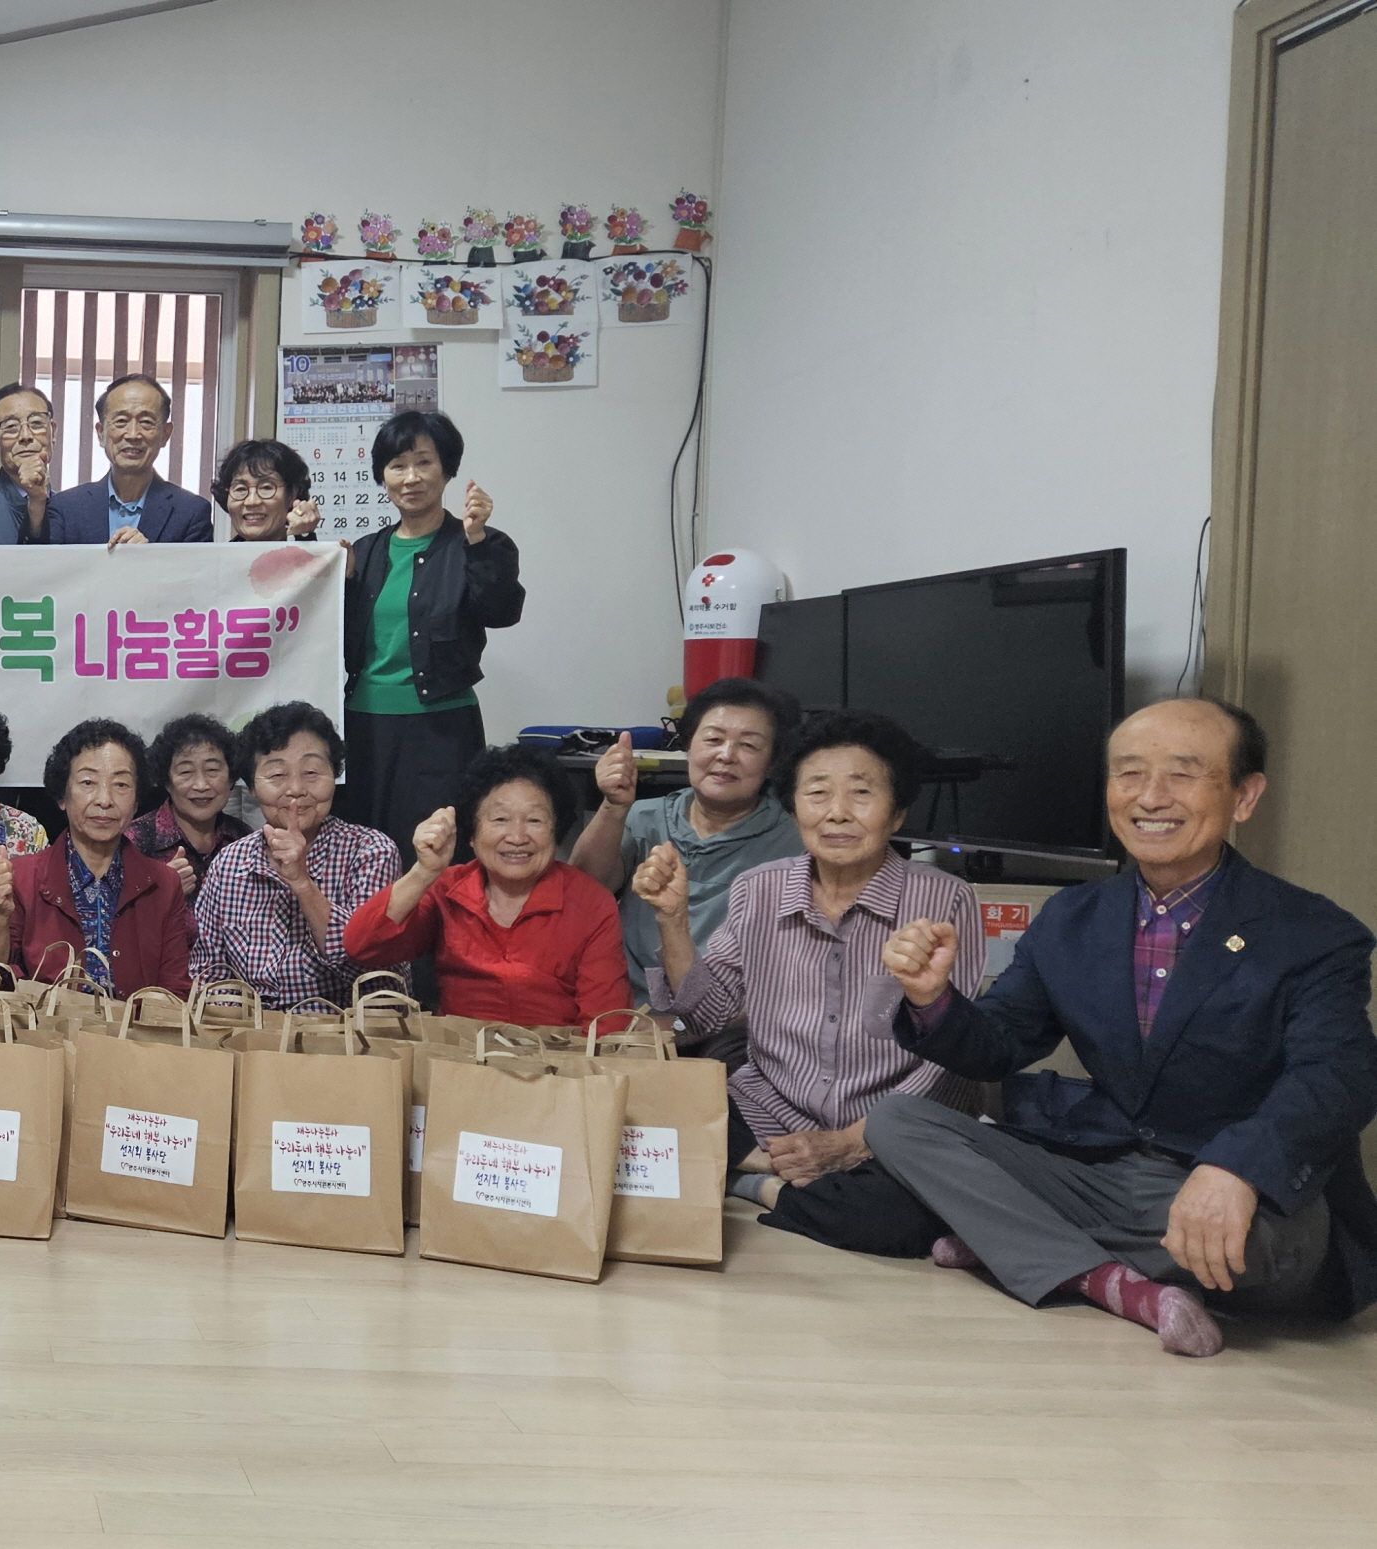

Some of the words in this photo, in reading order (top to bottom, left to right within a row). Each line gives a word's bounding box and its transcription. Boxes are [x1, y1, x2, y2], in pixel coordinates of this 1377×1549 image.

[286, 355, 310, 373] 10
[357, 424, 363, 435] 1
[313, 448, 321, 459] 6
[335, 448, 343, 459] 7
[357, 447, 365, 458] 8
[312, 471, 325, 483] 13
[333, 471, 346, 482] 14
[356, 470, 369, 481] 15
[312, 495, 325, 506] 20
[333, 494, 346, 505] 21
[355, 493, 369, 504] 22
[377, 493, 391, 504] 23
[334, 517, 347, 528] 28
[356, 516, 369, 527] 29
[378, 516, 391, 527] 30
[714, 602, 737, 611] 수거함
[75, 606, 300, 680] 나눔활동”
[143, 1129, 160, 1147] 행복
[120, 1144, 142, 1159] 선지회
[146, 1147, 167, 1163] 봉사단
[315, 1142, 333, 1159] 행복
[292, 1160, 315, 1173] 선지회
[319, 1160, 341, 1175] 봉사단
[501, 1157, 520, 1176] 행복
[475, 1172, 500, 1188] 선지회
[504, 1177, 528, 1193] 봉사단
